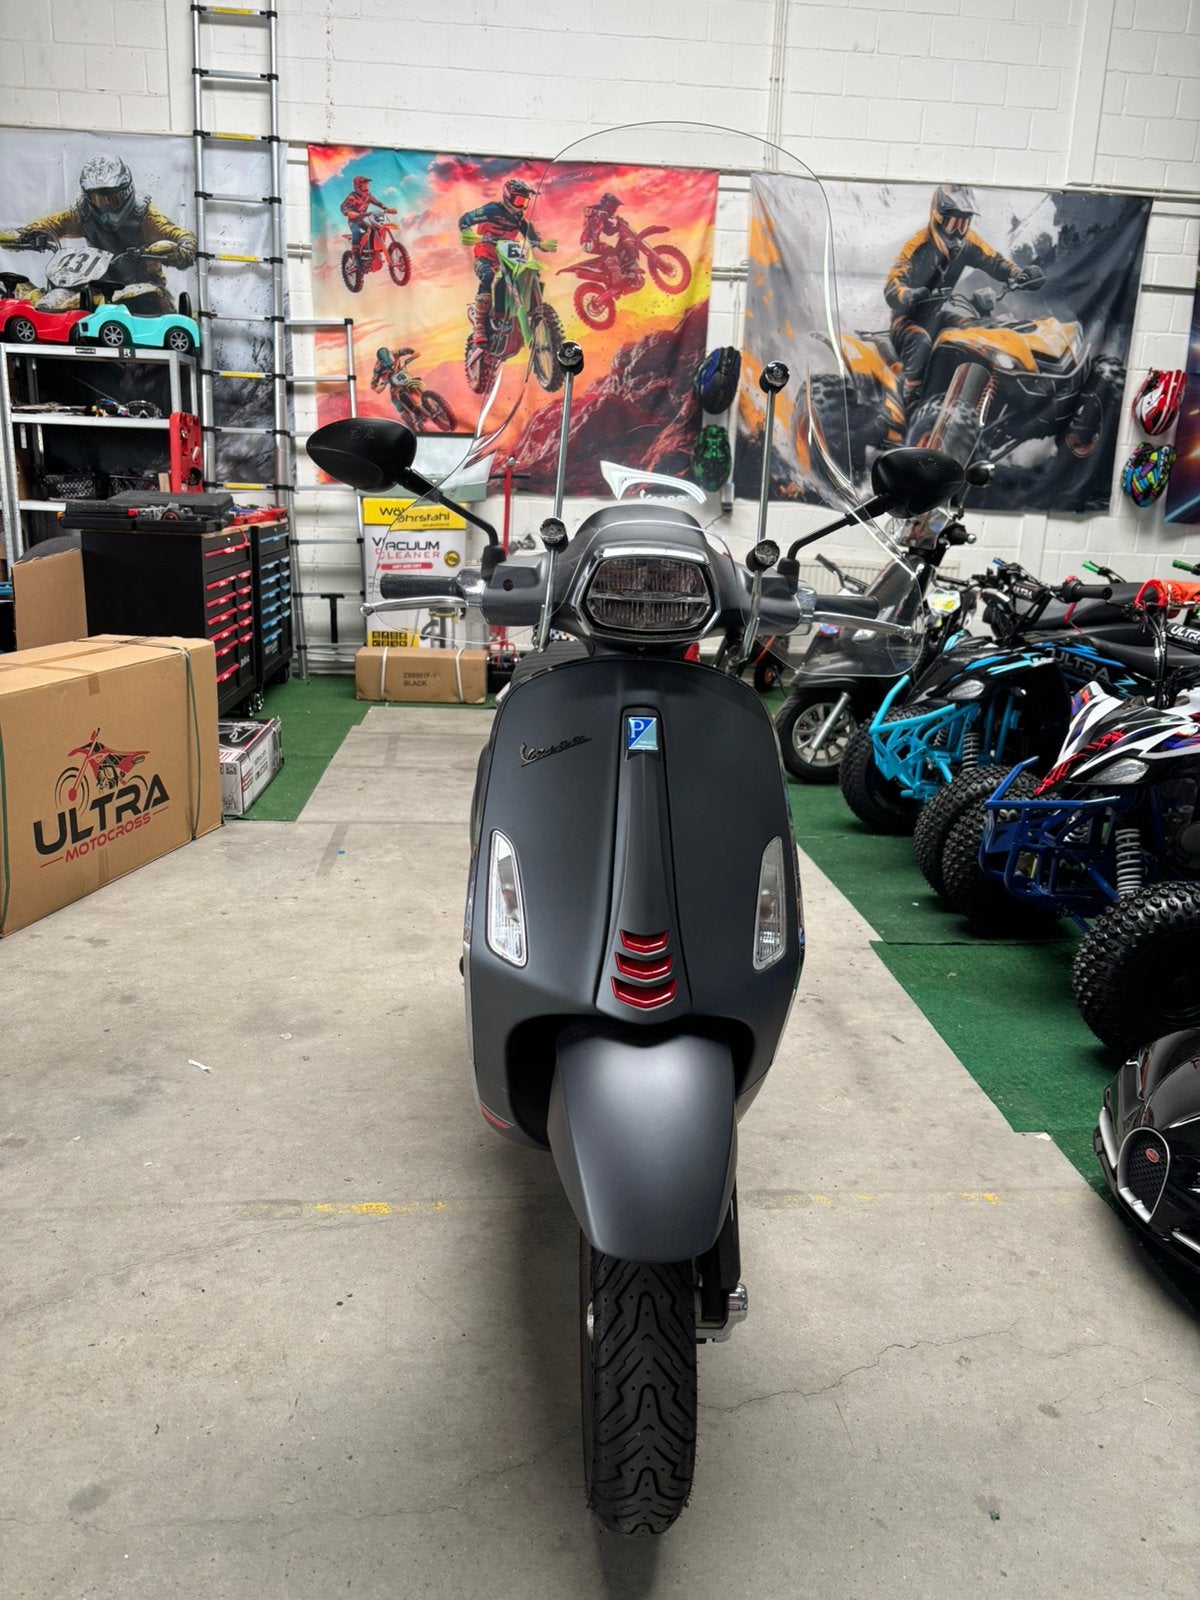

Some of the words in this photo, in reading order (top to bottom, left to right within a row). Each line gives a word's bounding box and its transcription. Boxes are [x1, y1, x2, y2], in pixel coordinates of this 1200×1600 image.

[372, 537, 440, 551] VACUUM
[375, 548, 440, 560] CLEANER
[1050, 649, 1113, 687] ULTRA
[630, 719, 645, 738] P
[33, 774, 170, 855] ULTRA
[65, 812, 151, 863] MOTOCROSS
